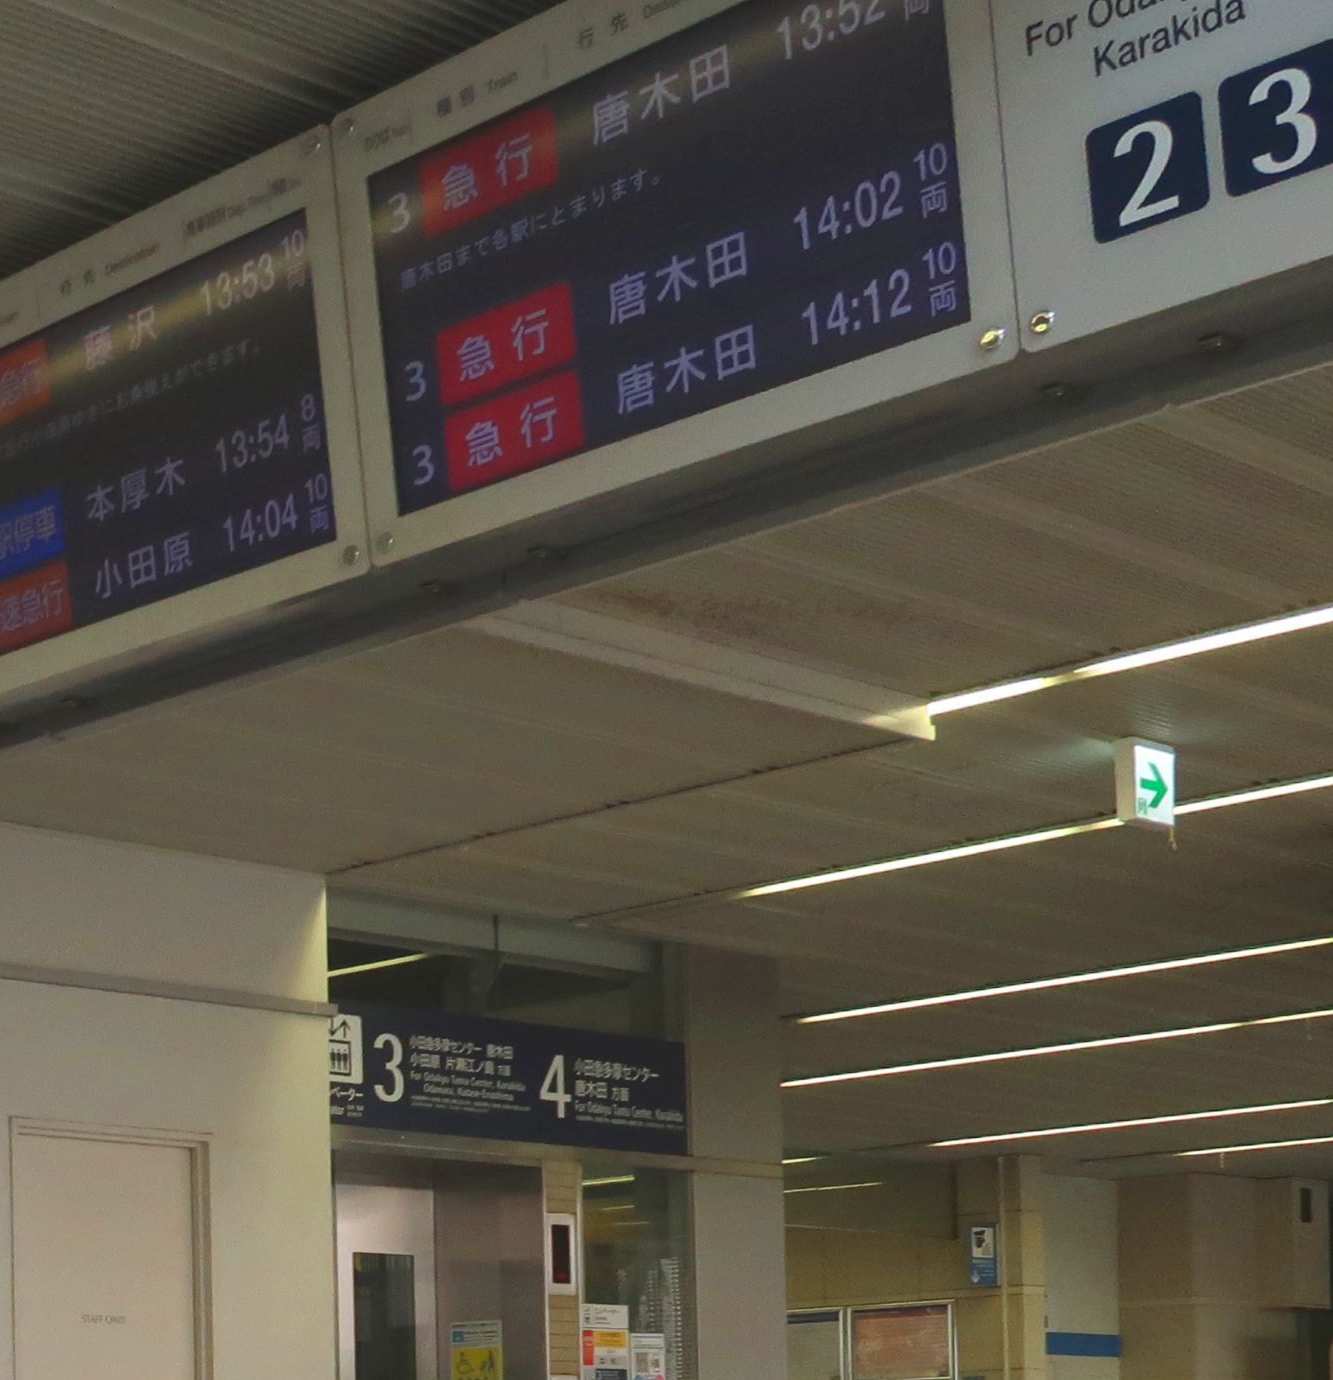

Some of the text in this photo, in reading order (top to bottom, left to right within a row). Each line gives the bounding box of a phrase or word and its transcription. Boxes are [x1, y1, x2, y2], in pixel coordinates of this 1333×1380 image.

[1025, 14, 1077, 56] For
[1094, 0, 1245, 76] Karakida
[387, 192, 411, 234] 3
[441, 133, 534, 211] 急行
[591, 45, 732, 146] 唐木田
[1113, 67, 1318, 227] 2 3
[200, 253, 275, 315] 13:53
[282, 230, 305, 259] 10
[404, 142, 949, 402] 3 急行 唐木田 14:02 10 両
[412, 242, 958, 486] 3 急行 唐木田 14:12 10 両
[86, 456, 187, 523] 本厚木
[215, 414, 291, 473] 13:54
[301, 394, 316, 421] 8
[94, 531, 196, 600] 小田原
[223, 494, 299, 553] 14:04
[304, 473, 328, 504] 10
[373, 1033, 406, 1103] 3
[539, 1054, 572, 1119] 4
